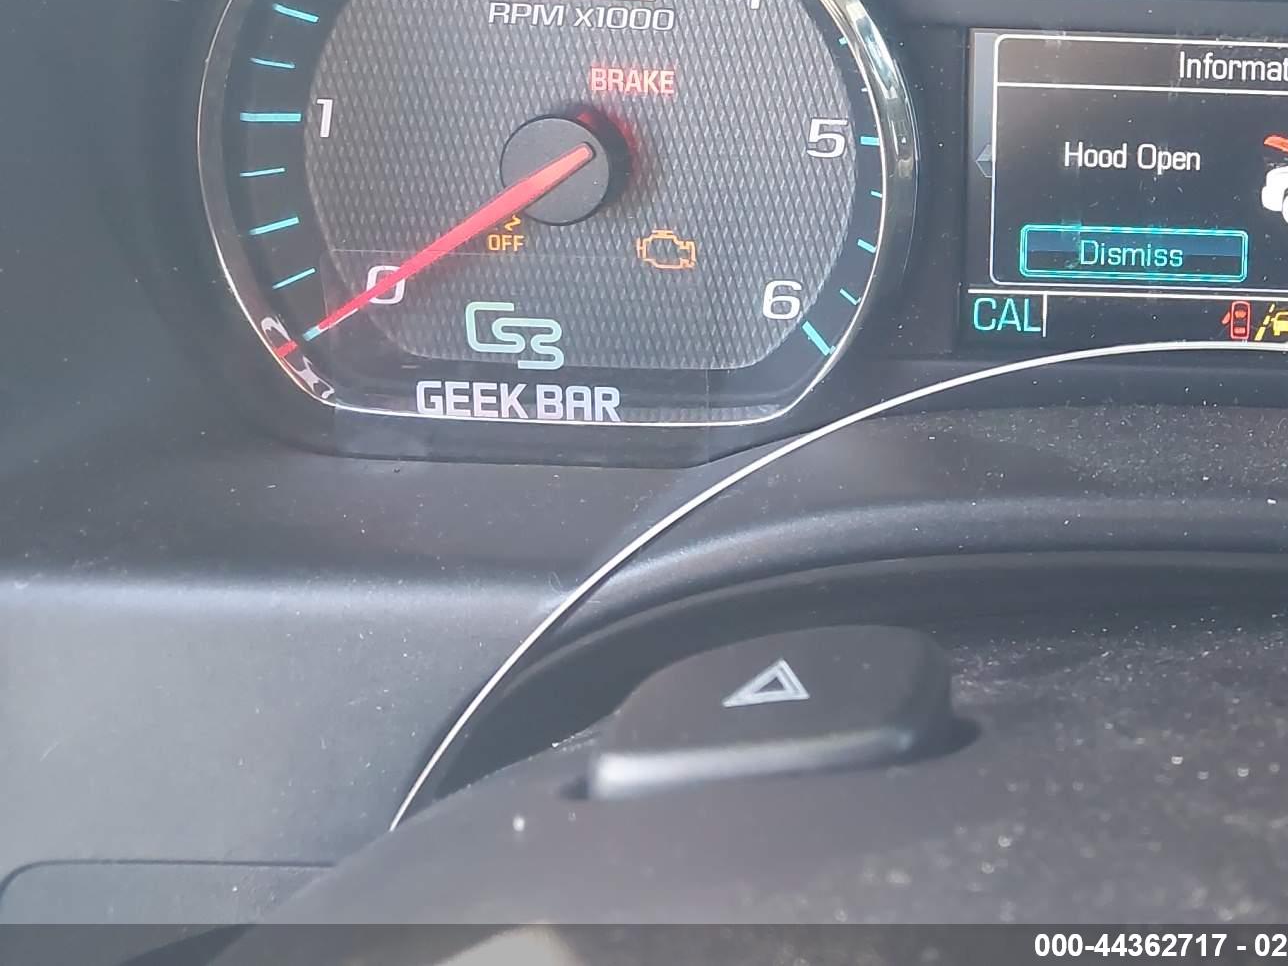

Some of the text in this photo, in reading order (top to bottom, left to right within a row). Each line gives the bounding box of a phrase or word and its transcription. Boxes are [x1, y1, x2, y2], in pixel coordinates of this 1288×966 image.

[488, 2, 565, 26] RPM
[590, 67, 676, 95] BRAKE
[316, 99, 334, 137] 1
[807, 118, 848, 158] 5
[1063, 143, 1201, 174] Hood Open
[488, 234, 523, 251] OFF
[1080, 240, 1183, 268] Dismiss
[762, 281, 802, 319] 6
[973, 297, 1041, 332] CAL
[416, 381, 621, 422] GEEK BAR
